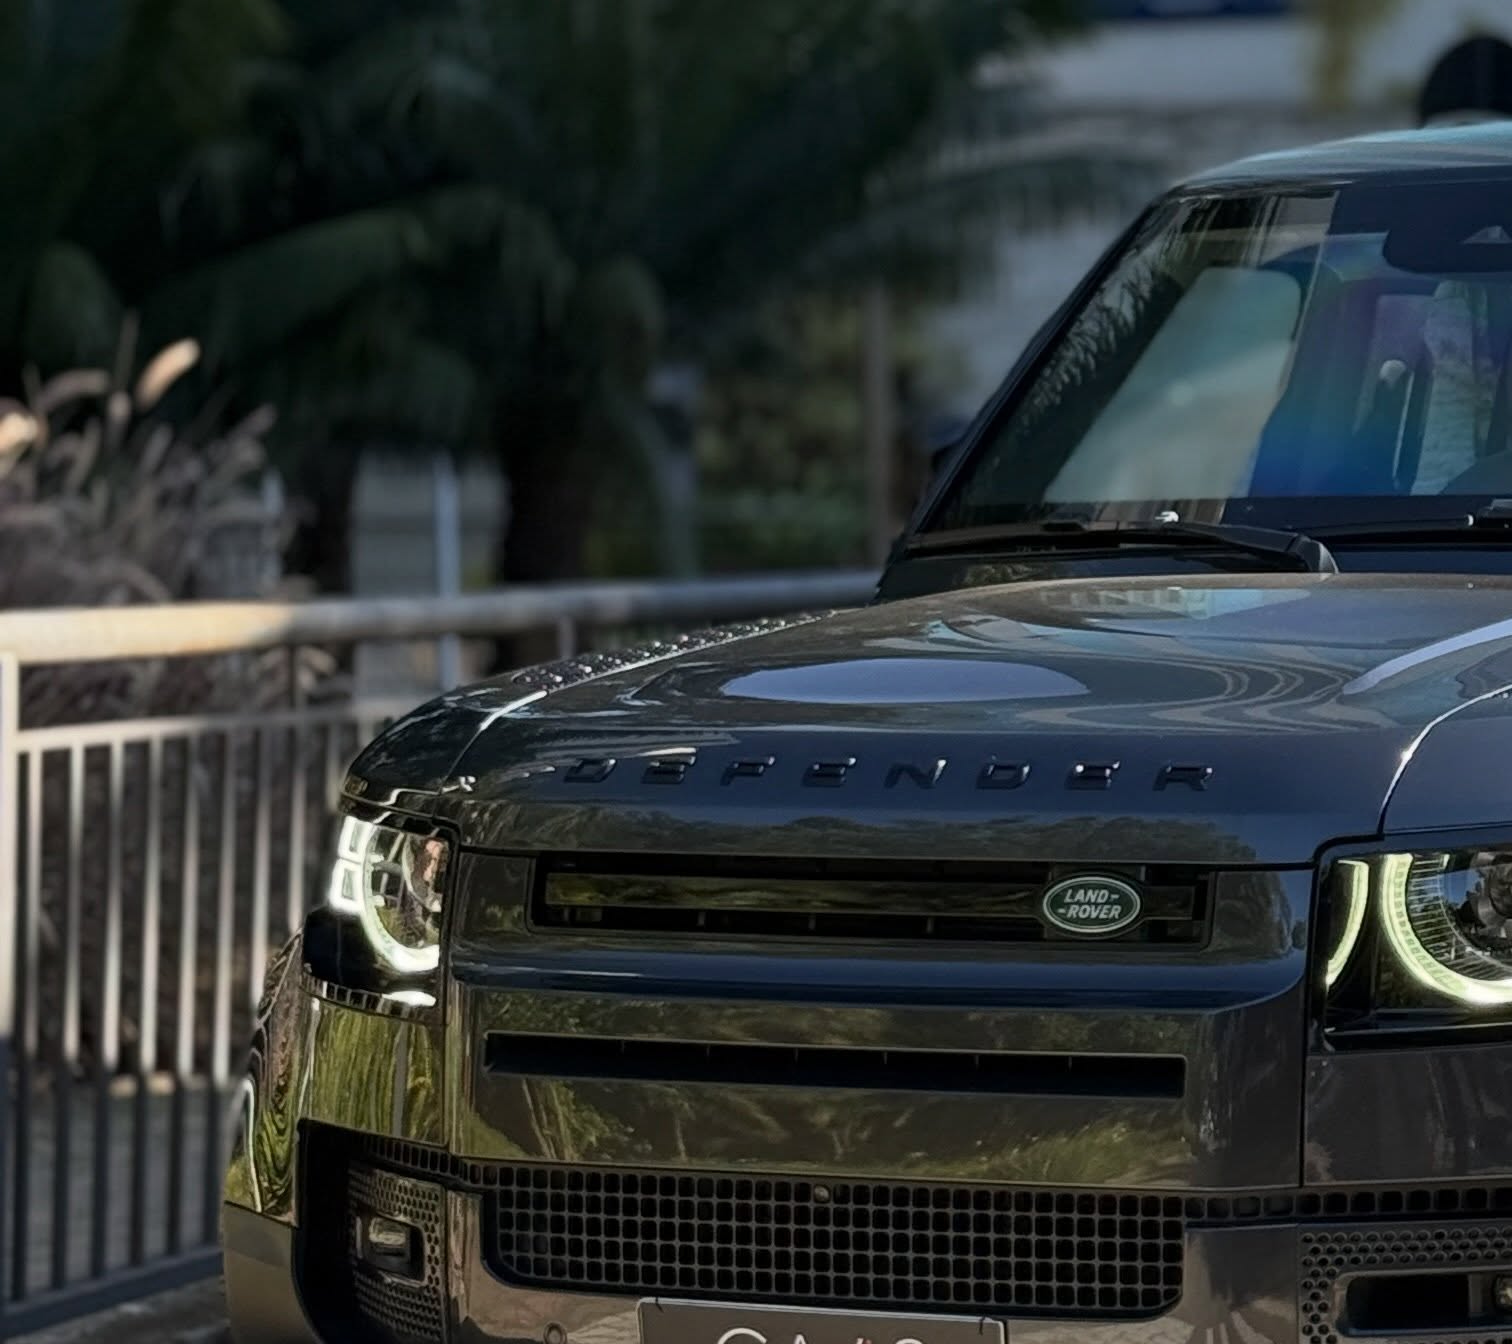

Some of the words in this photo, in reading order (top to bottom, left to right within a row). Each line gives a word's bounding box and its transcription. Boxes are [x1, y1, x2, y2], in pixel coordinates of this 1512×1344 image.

[564, 756, 1213, 791] DEFENDER
[1064, 889, 1109, 903] LAND
[1067, 905, 1121, 918] ROVER
